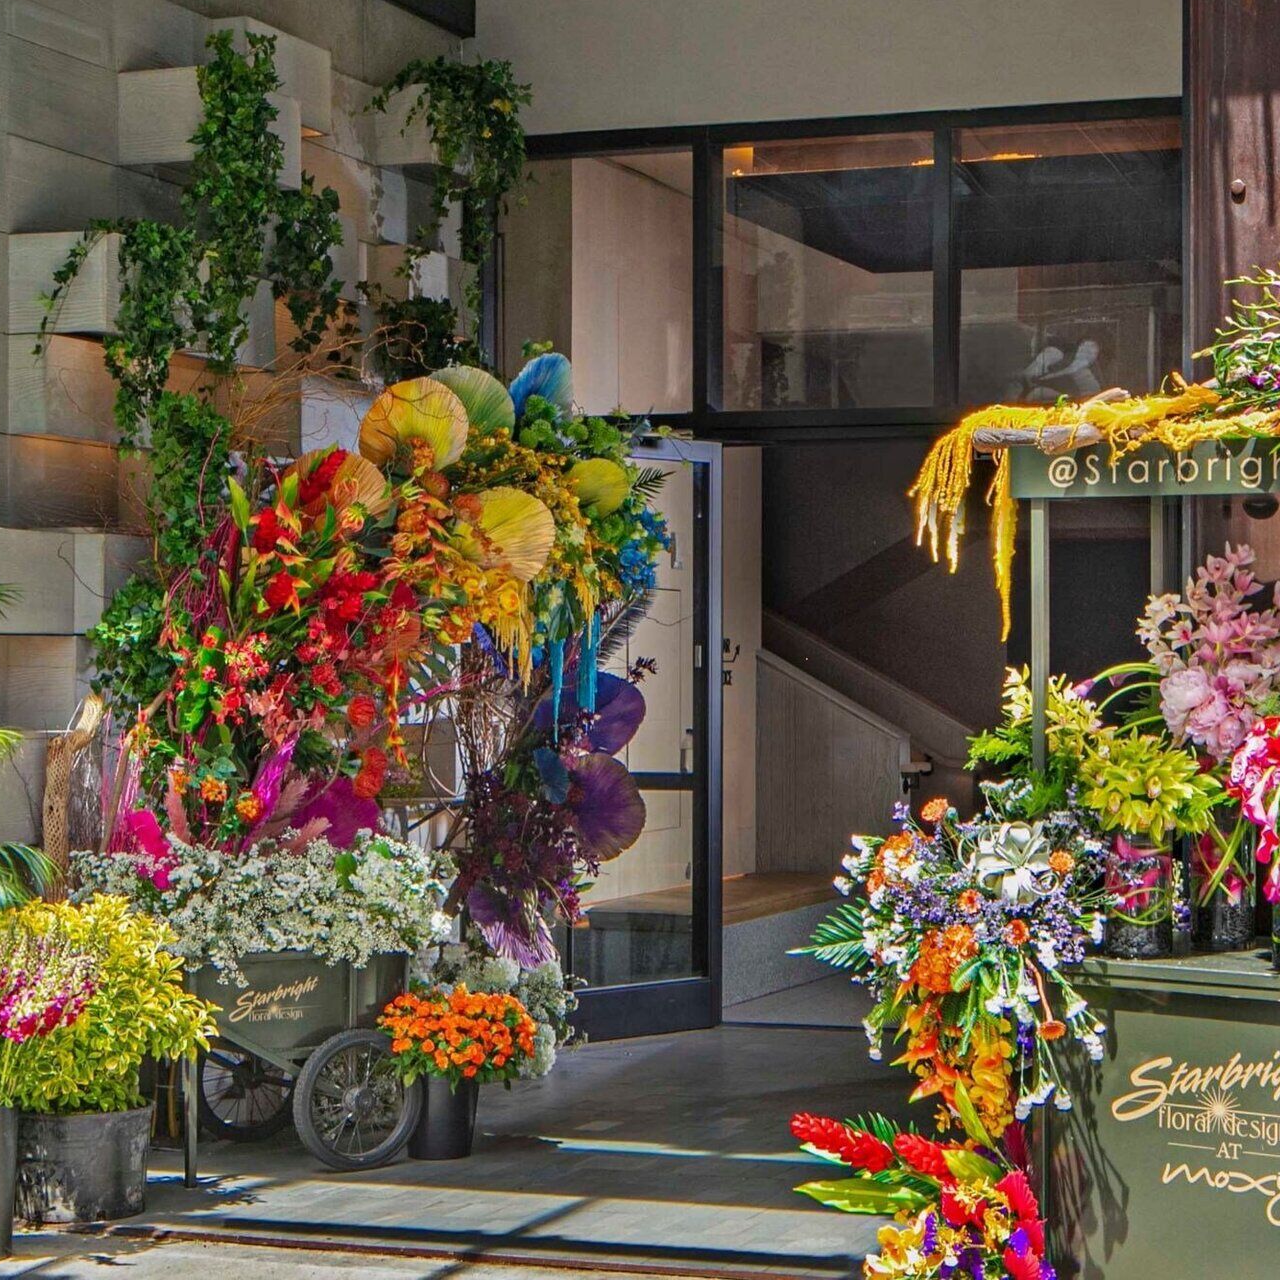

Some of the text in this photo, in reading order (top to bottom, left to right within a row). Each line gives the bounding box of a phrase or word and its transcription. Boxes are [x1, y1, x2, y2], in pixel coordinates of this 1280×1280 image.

[228, 976, 319, 1022] Starbright
[1158, 1106, 1212, 1133] floral
[1216, 1143, 1243, 1160] AT
